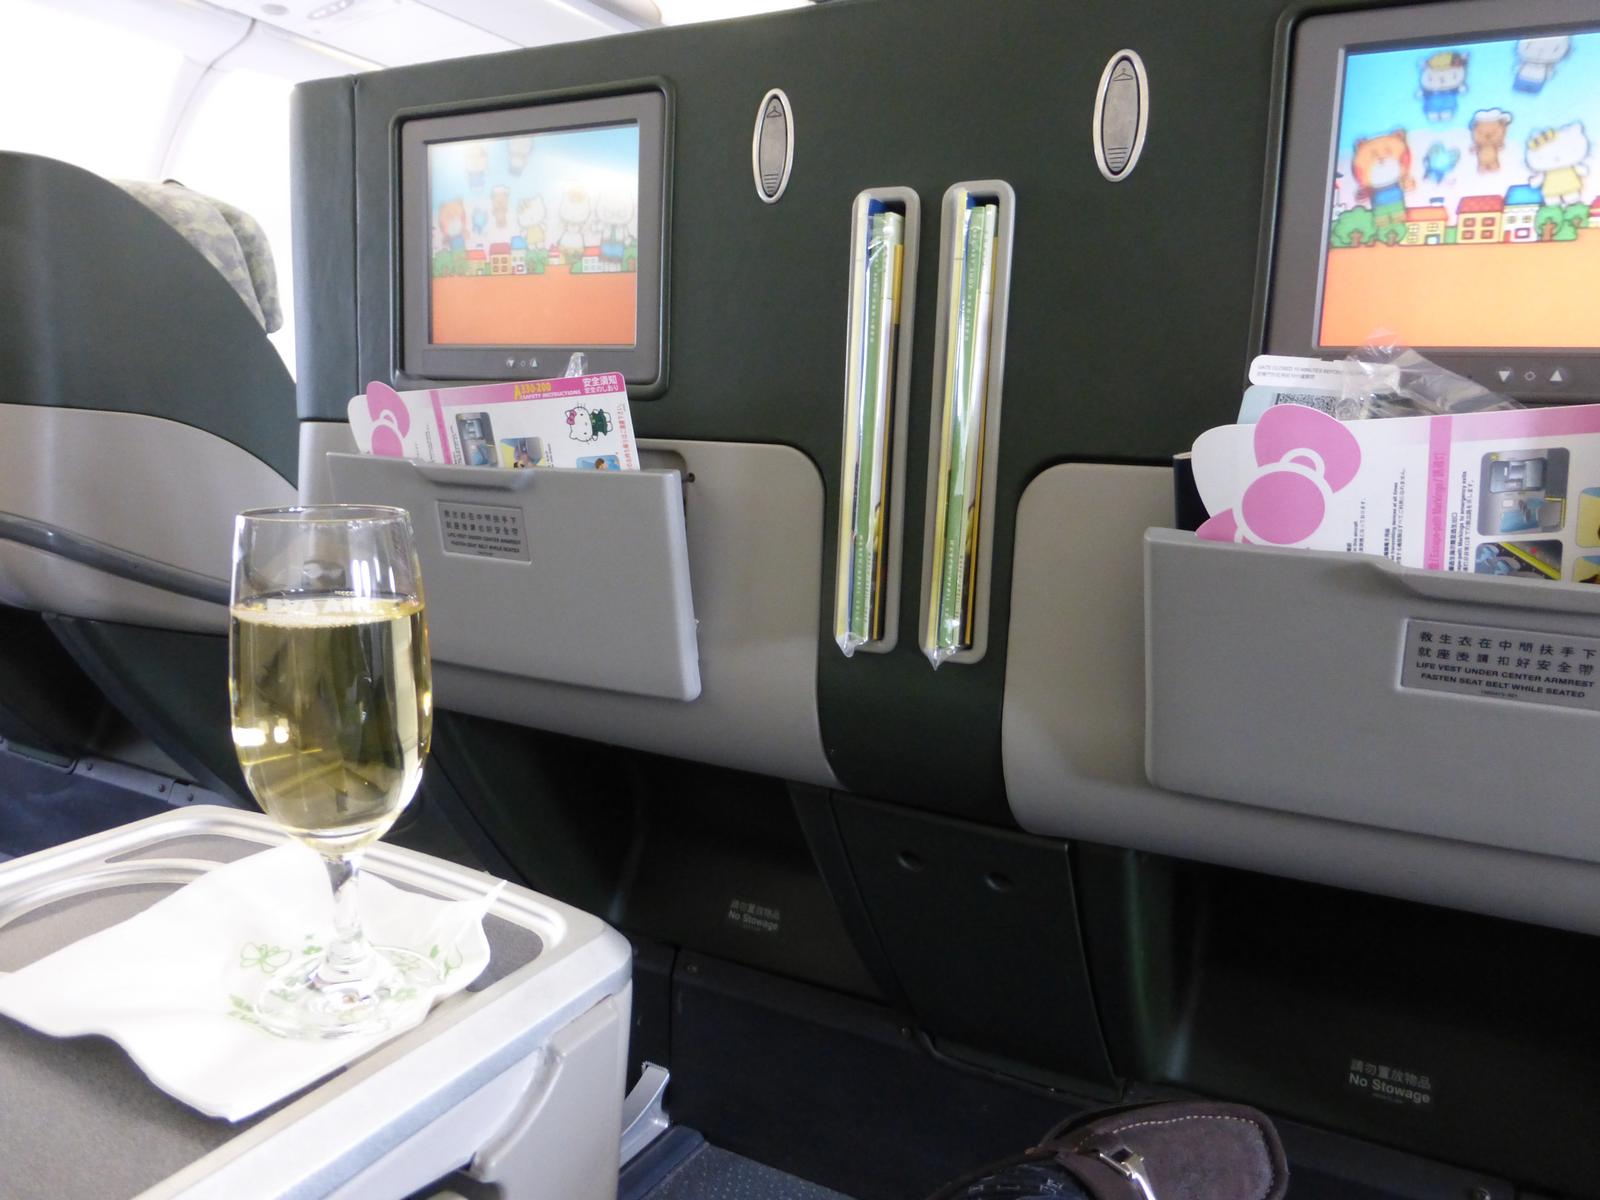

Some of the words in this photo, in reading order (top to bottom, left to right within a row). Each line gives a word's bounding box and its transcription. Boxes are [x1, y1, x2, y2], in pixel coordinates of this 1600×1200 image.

[1432, 481, 1446, 513] Markings
[1420, 631, 1597, 659] 救生衣在中間扶手下
[1416, 661, 1435, 670] LIFE
[1438, 664, 1461, 673] VEST
[1465, 667, 1499, 677] UNDER
[1501, 671, 1541, 682] CENTER
[1544, 677, 1595, 688] ARMREST
[1421, 672, 1456, 683] FASTEN
[1459, 677, 1483, 686] SEAT
[1485, 680, 1509, 690] BELT
[1511, 683, 1543, 694] WHILE
[1546, 687, 1585, 698] SEATED
[728, 910, 741, 920] No
[743, 913, 778, 931] Stowage
[1349, 1072, 1368, 1087] No
[1372, 1078, 1430, 1104] Stowage
